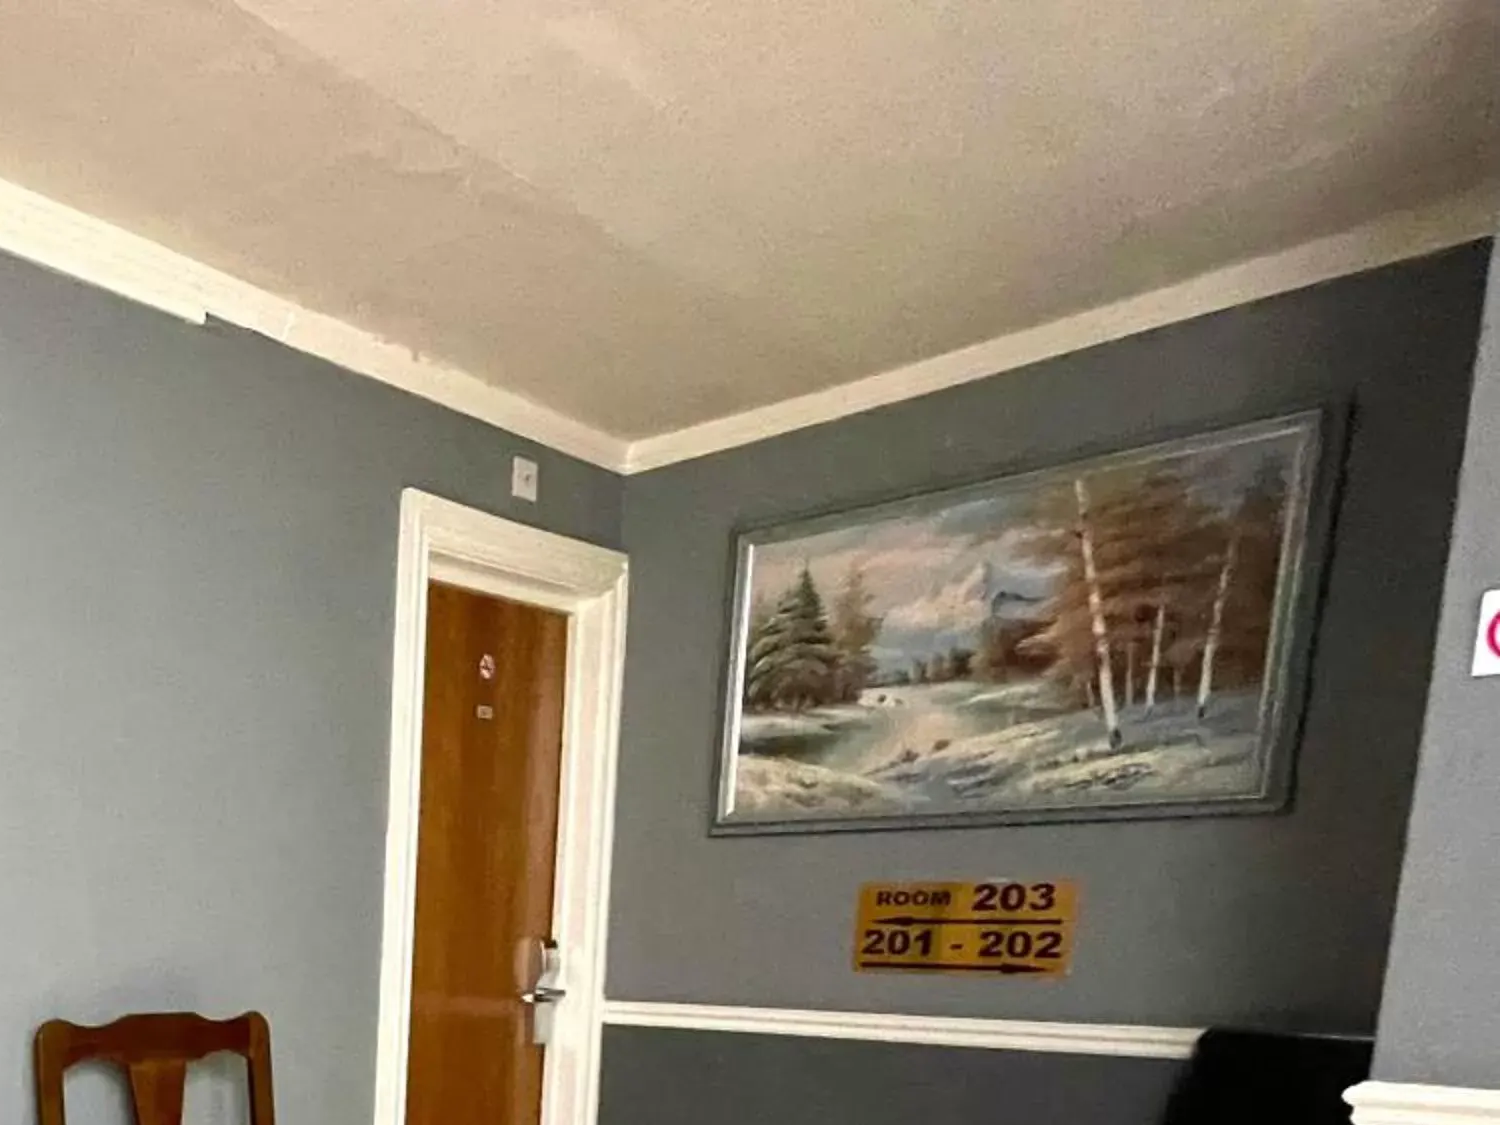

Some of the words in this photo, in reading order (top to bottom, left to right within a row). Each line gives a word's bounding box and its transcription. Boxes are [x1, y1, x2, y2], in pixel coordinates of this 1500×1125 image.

[875, 890, 952, 907] ROOM
[971, 882, 1056, 912] 203
[861, 929, 933, 956] 201
[978, 930, 1063, 959] 202
